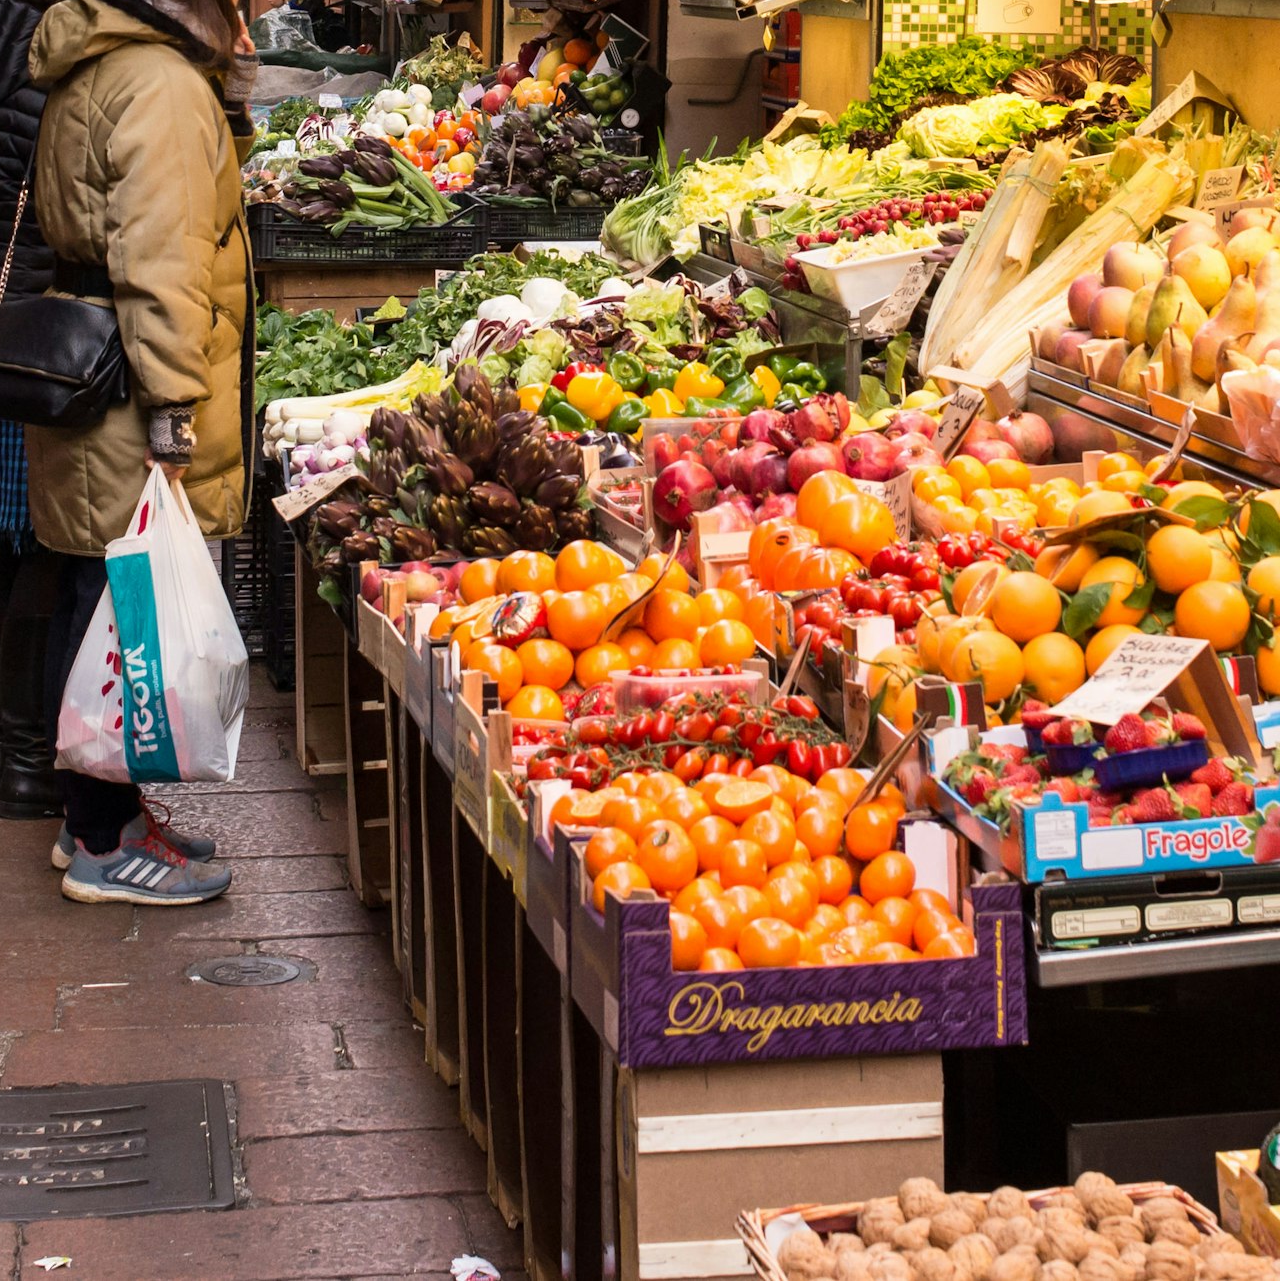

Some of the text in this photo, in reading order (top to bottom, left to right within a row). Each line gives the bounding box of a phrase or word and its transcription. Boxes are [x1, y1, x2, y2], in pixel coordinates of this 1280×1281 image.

[150, 659, 161, 697] profumati
[1145, 822, 1251, 861] Fragole
[663, 980, 924, 1054] Dragarancia
